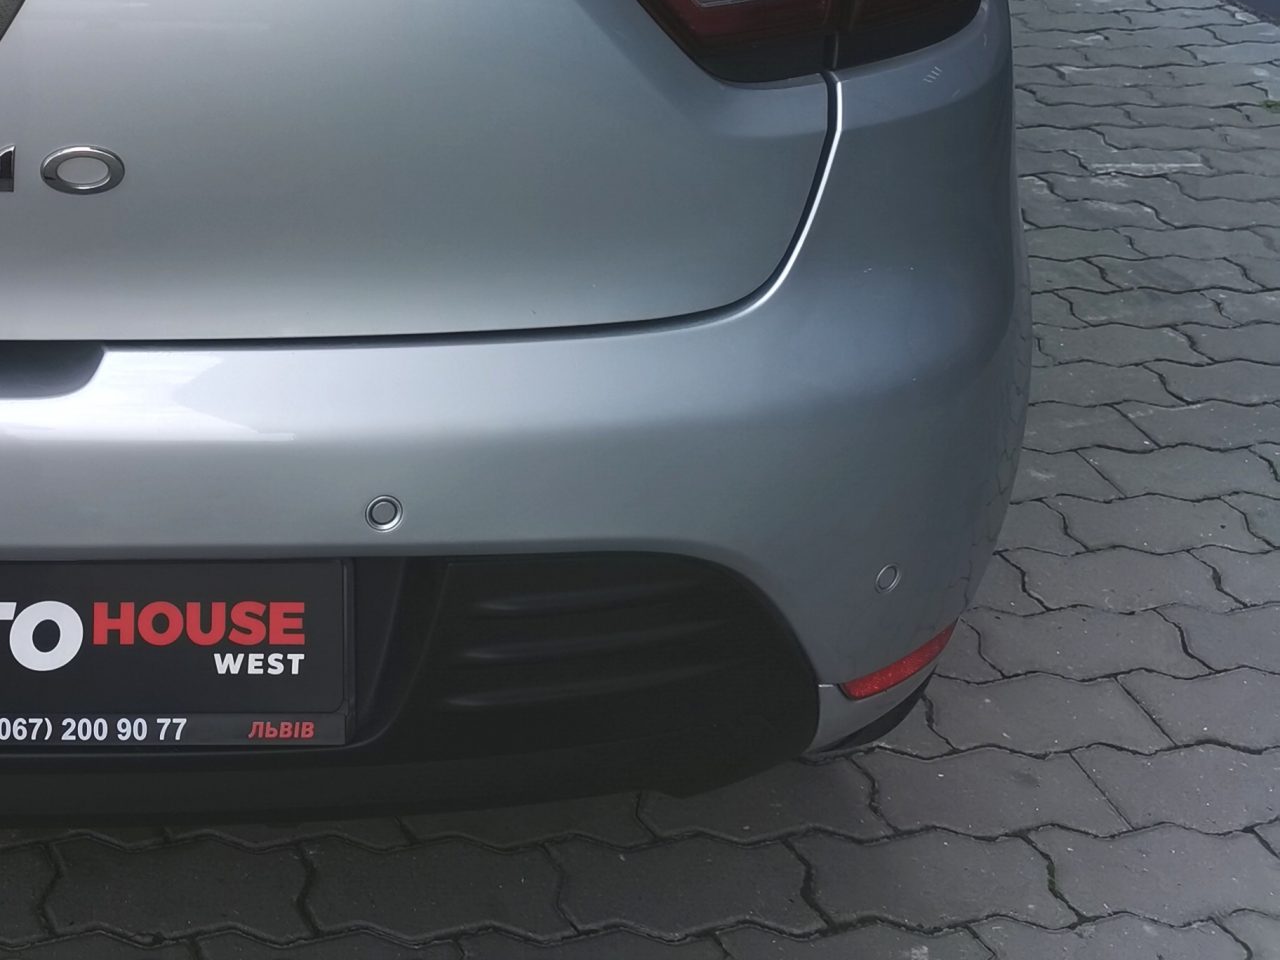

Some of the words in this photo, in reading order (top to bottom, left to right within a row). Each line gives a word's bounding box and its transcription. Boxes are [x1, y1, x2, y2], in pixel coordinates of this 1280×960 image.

[93, 601, 306, 647] HOUSE
[214, 652, 306, 675] WEST
[61, 717, 108, 741] 200
[117, 717, 148, 741] 90
[157, 717, 187, 740] 77
[248, 721, 315, 739] ЛЬВІВ
